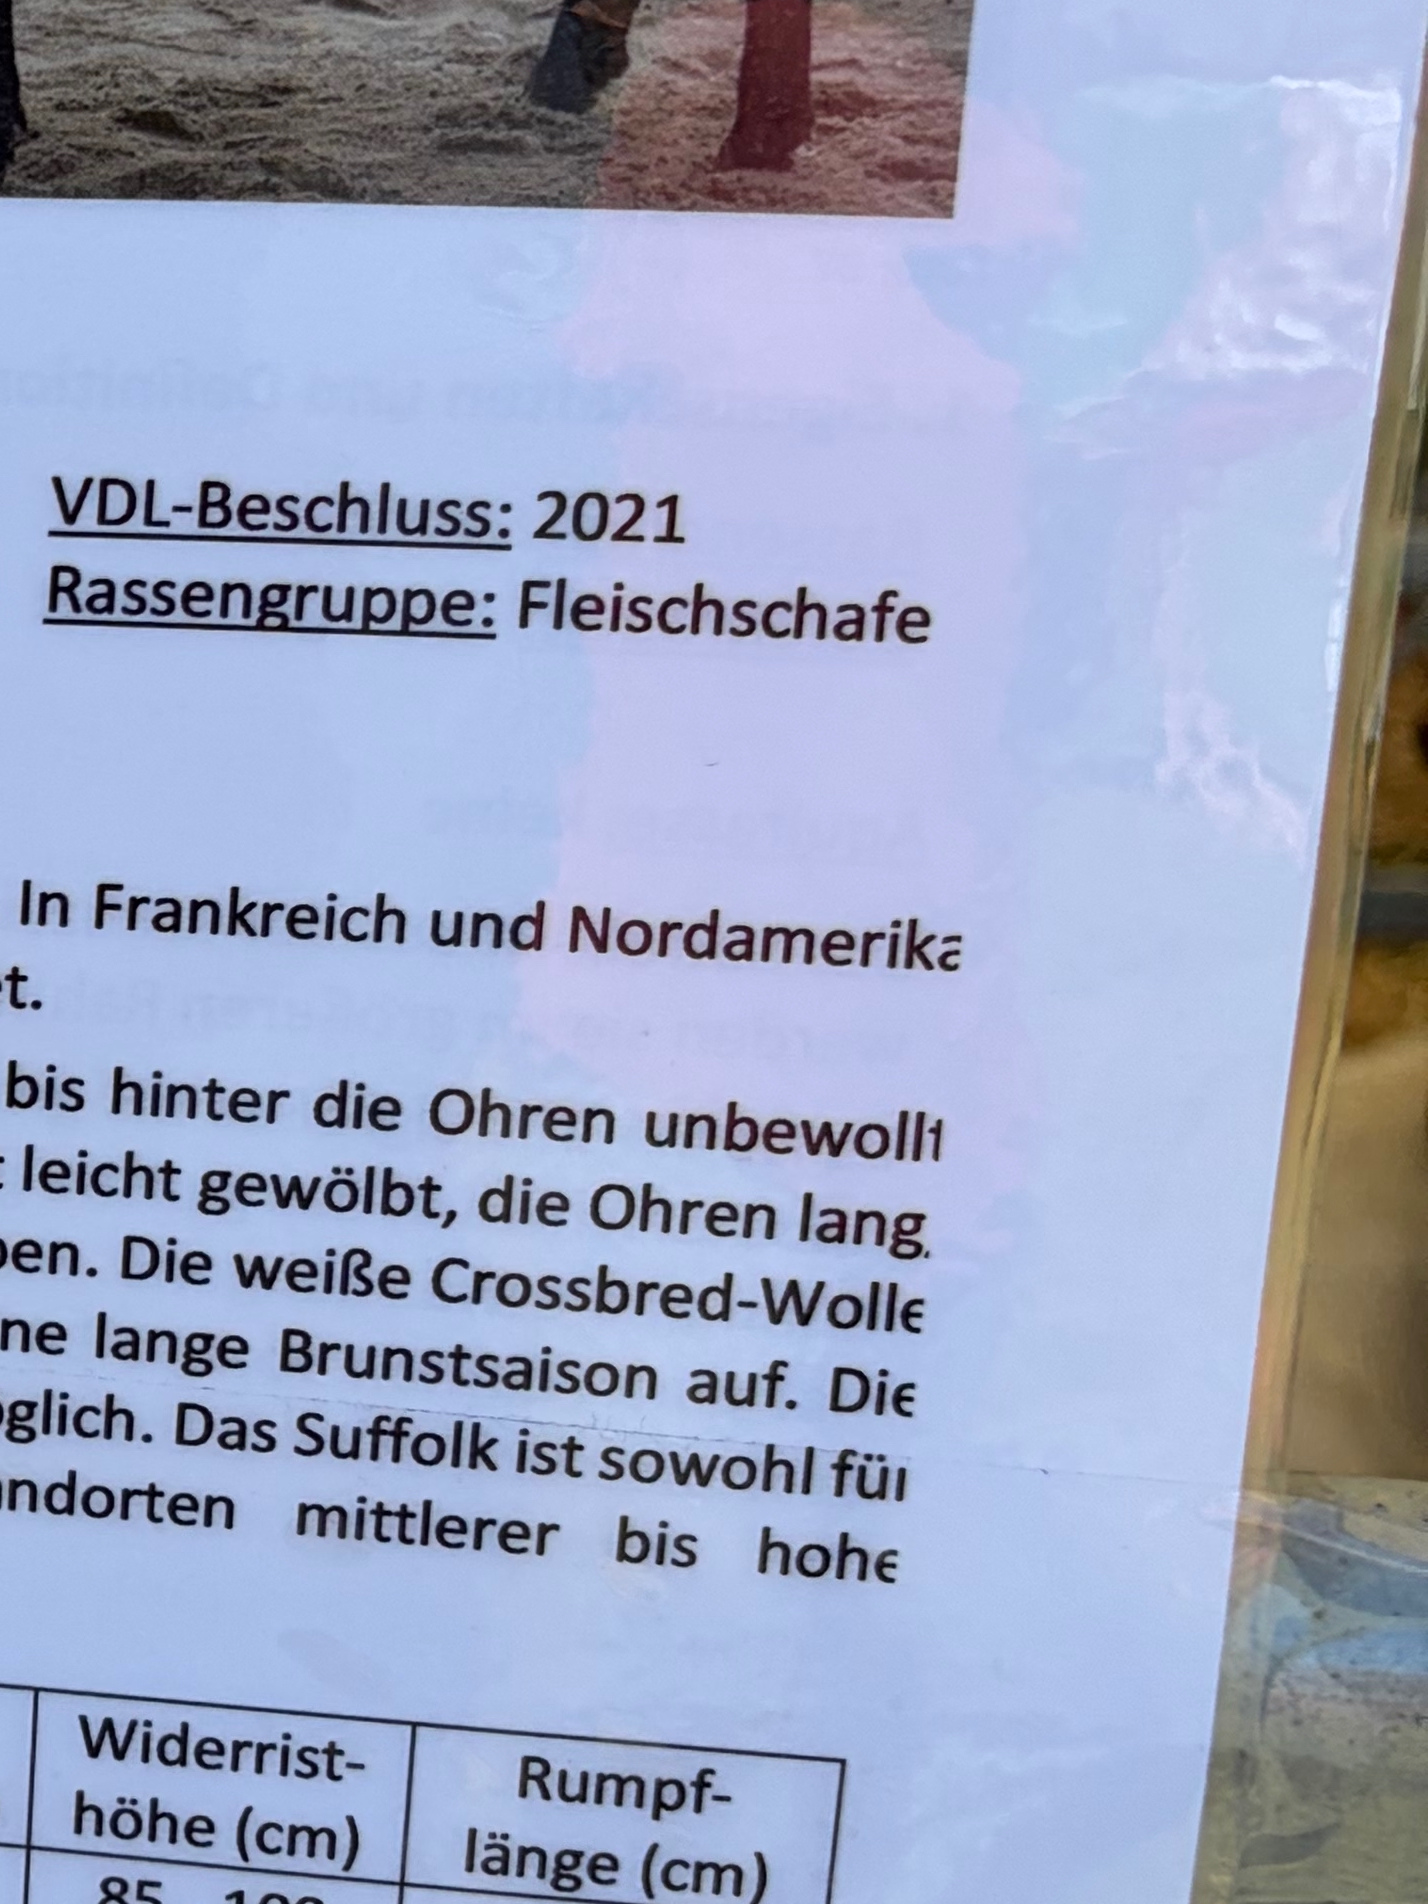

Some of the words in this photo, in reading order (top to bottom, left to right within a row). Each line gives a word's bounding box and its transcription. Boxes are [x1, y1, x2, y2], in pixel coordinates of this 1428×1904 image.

[50, 475, 513, 540] VDL-Beschluss:
[532, 490, 686, 545] 2021
[41, 564, 498, 641] Rassengruppe:
[518, 577, 932, 645] Fleischschafe
[19, 878, 70, 929] In
[94, 882, 407, 945] Frankreich
[429, 899, 547, 952] und
[5, 1059, 86, 1113] bis
[110, 1065, 291, 1125] hinter
[312, 1078, 403, 1133] die
[428, 1086, 616, 1145] Ohren
[95, 1311, 250, 1378] lange
[279, 1327, 658, 1401] Brunstsaison
[685, 1359, 798, 1411] auf.
[77, 1714, 366, 1783] Widerrist-
[517, 1755, 733, 1822] Rumpf-
[73, 1789, 216, 1849] höhe
[235, 1805, 360, 1873] (cm)
[464, 1827, 621, 1894] länge
